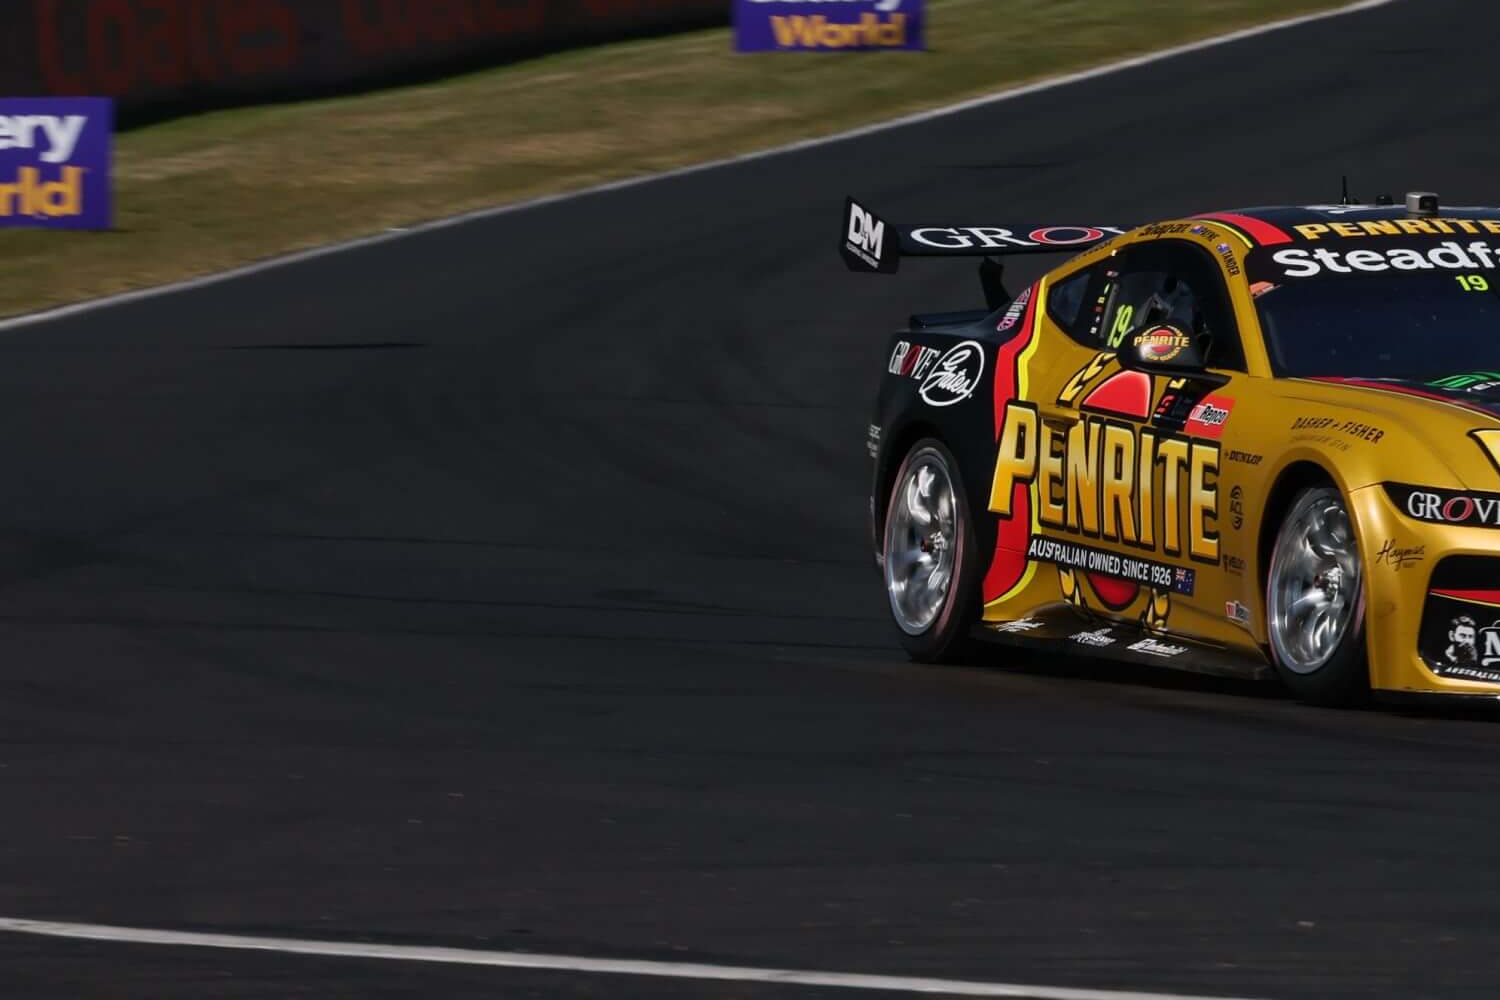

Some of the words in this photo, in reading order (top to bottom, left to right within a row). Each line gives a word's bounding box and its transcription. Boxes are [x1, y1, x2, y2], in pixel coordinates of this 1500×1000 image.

[769, 12, 906, 47] World
[1455, 275, 1489, 292] 19
[1107, 304, 1133, 348] 19
[1134, 334, 1190, 348] PENRITE
[889, 341, 941, 379] GROVE
[1200, 403, 1229, 426] Repco
[1340, 421, 1385, 444] FISHER
[988, 401, 1220, 561] PENRITE
[1028, 539, 1087, 567] AUSTRALIAN
[1088, 552, 1120, 575] OWNED
[1122, 559, 1149, 581] SINCE
[1150, 566, 1172, 586] 1926
